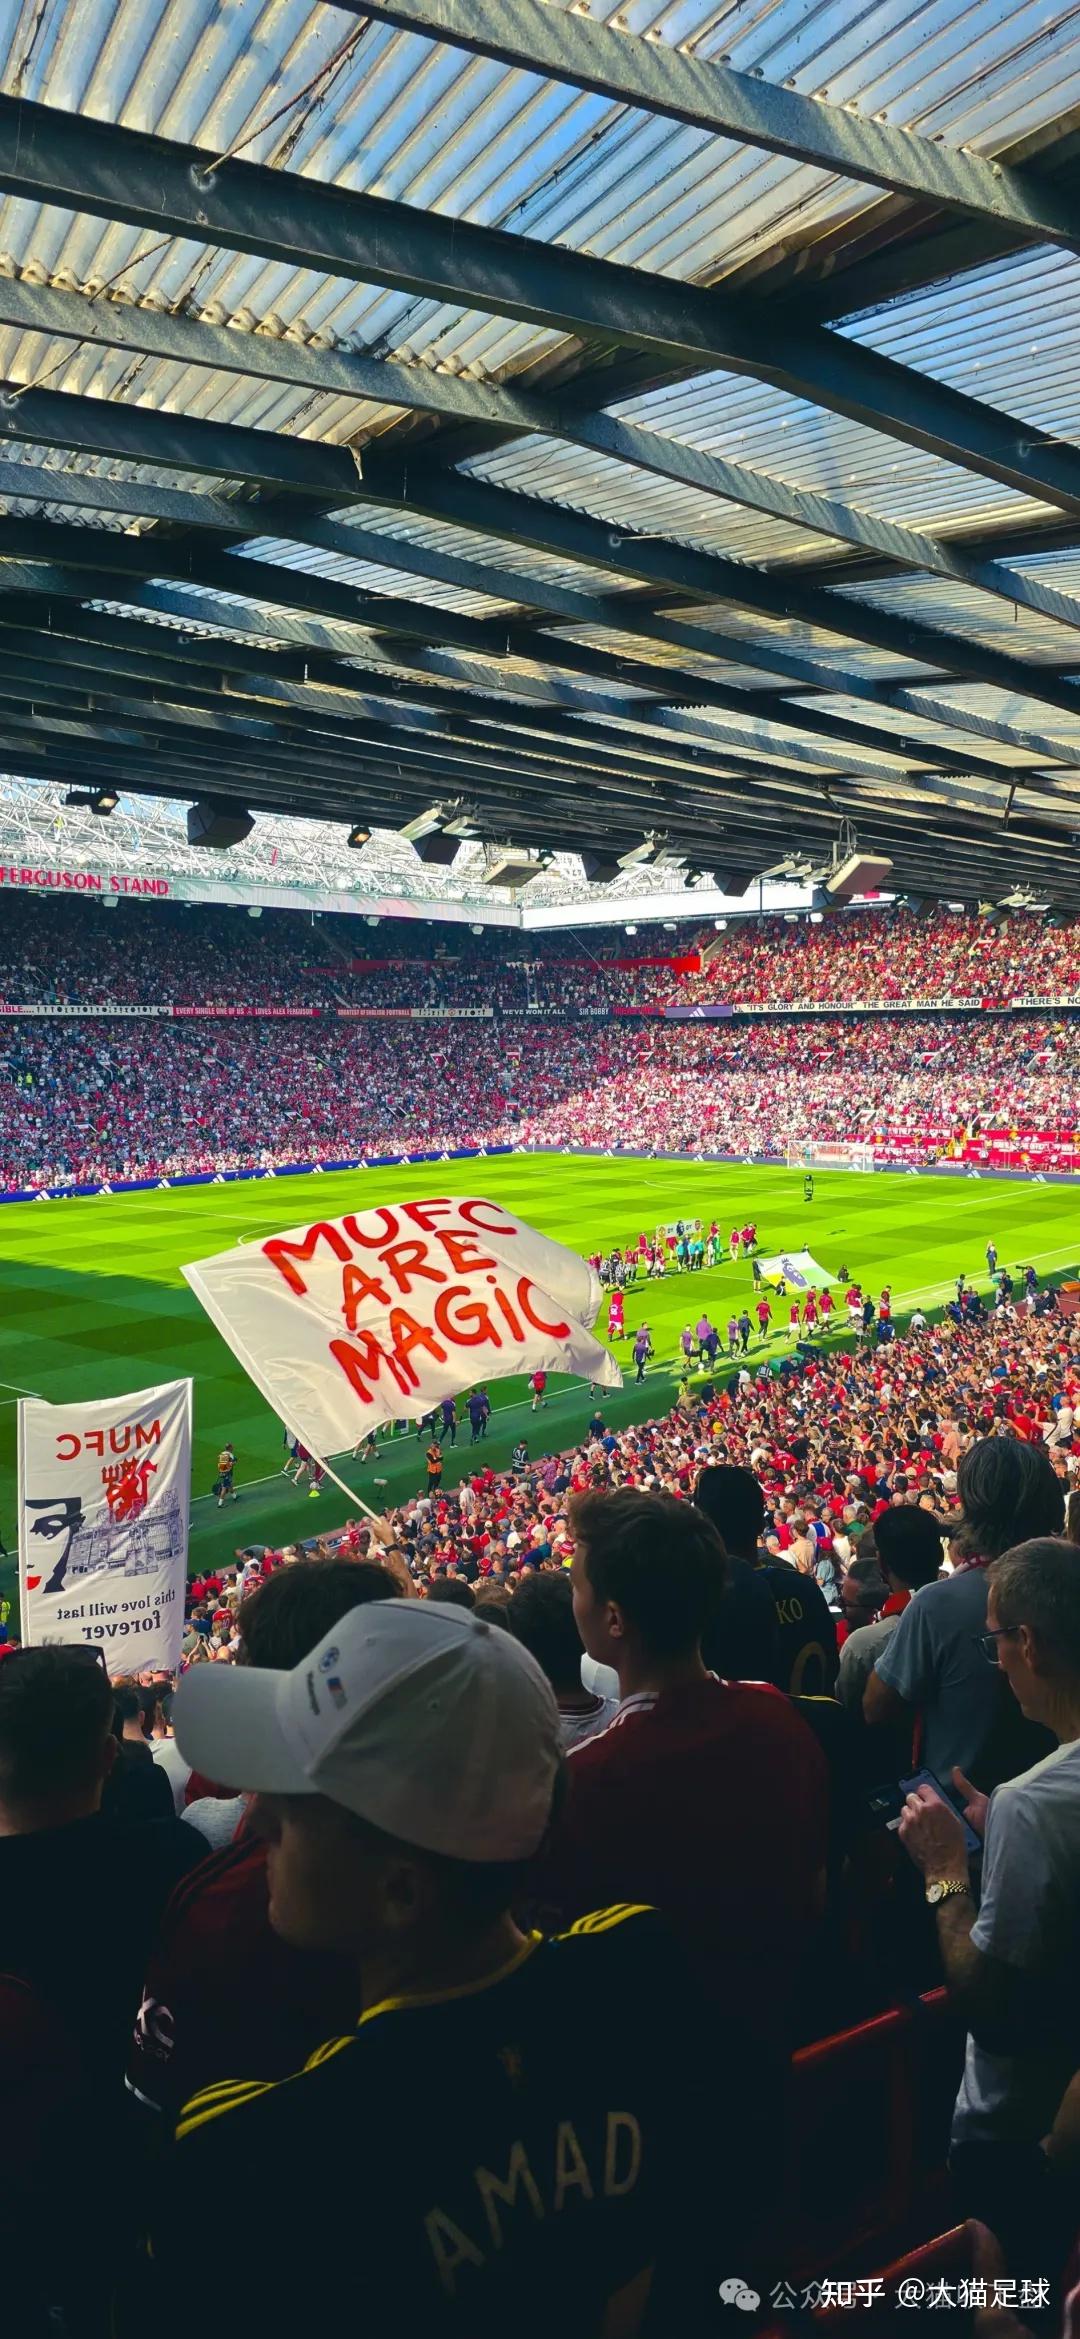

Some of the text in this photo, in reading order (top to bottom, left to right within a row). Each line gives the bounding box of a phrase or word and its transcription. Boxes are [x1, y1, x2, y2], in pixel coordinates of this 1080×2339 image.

[0, 866, 169, 895] FERGUSON STAND
[176, 1007, 313, 1015] EVERY SINGLE ONE OF US LOVES ALEX FERGUSON
[579, 1008, 589, 1016] SIR
[590, 1007, 609, 1015] BOBBY
[767, 1003, 794, 1011] GLORY
[863, 1001, 879, 1009] THE
[916, 1000, 937, 1008] MAN
[958, 999, 980, 1007] SAID
[262, 1198, 518, 1296] MUFC
[341, 1229, 498, 1331] ARE
[423, 2110, 643, 2297] AMAD
